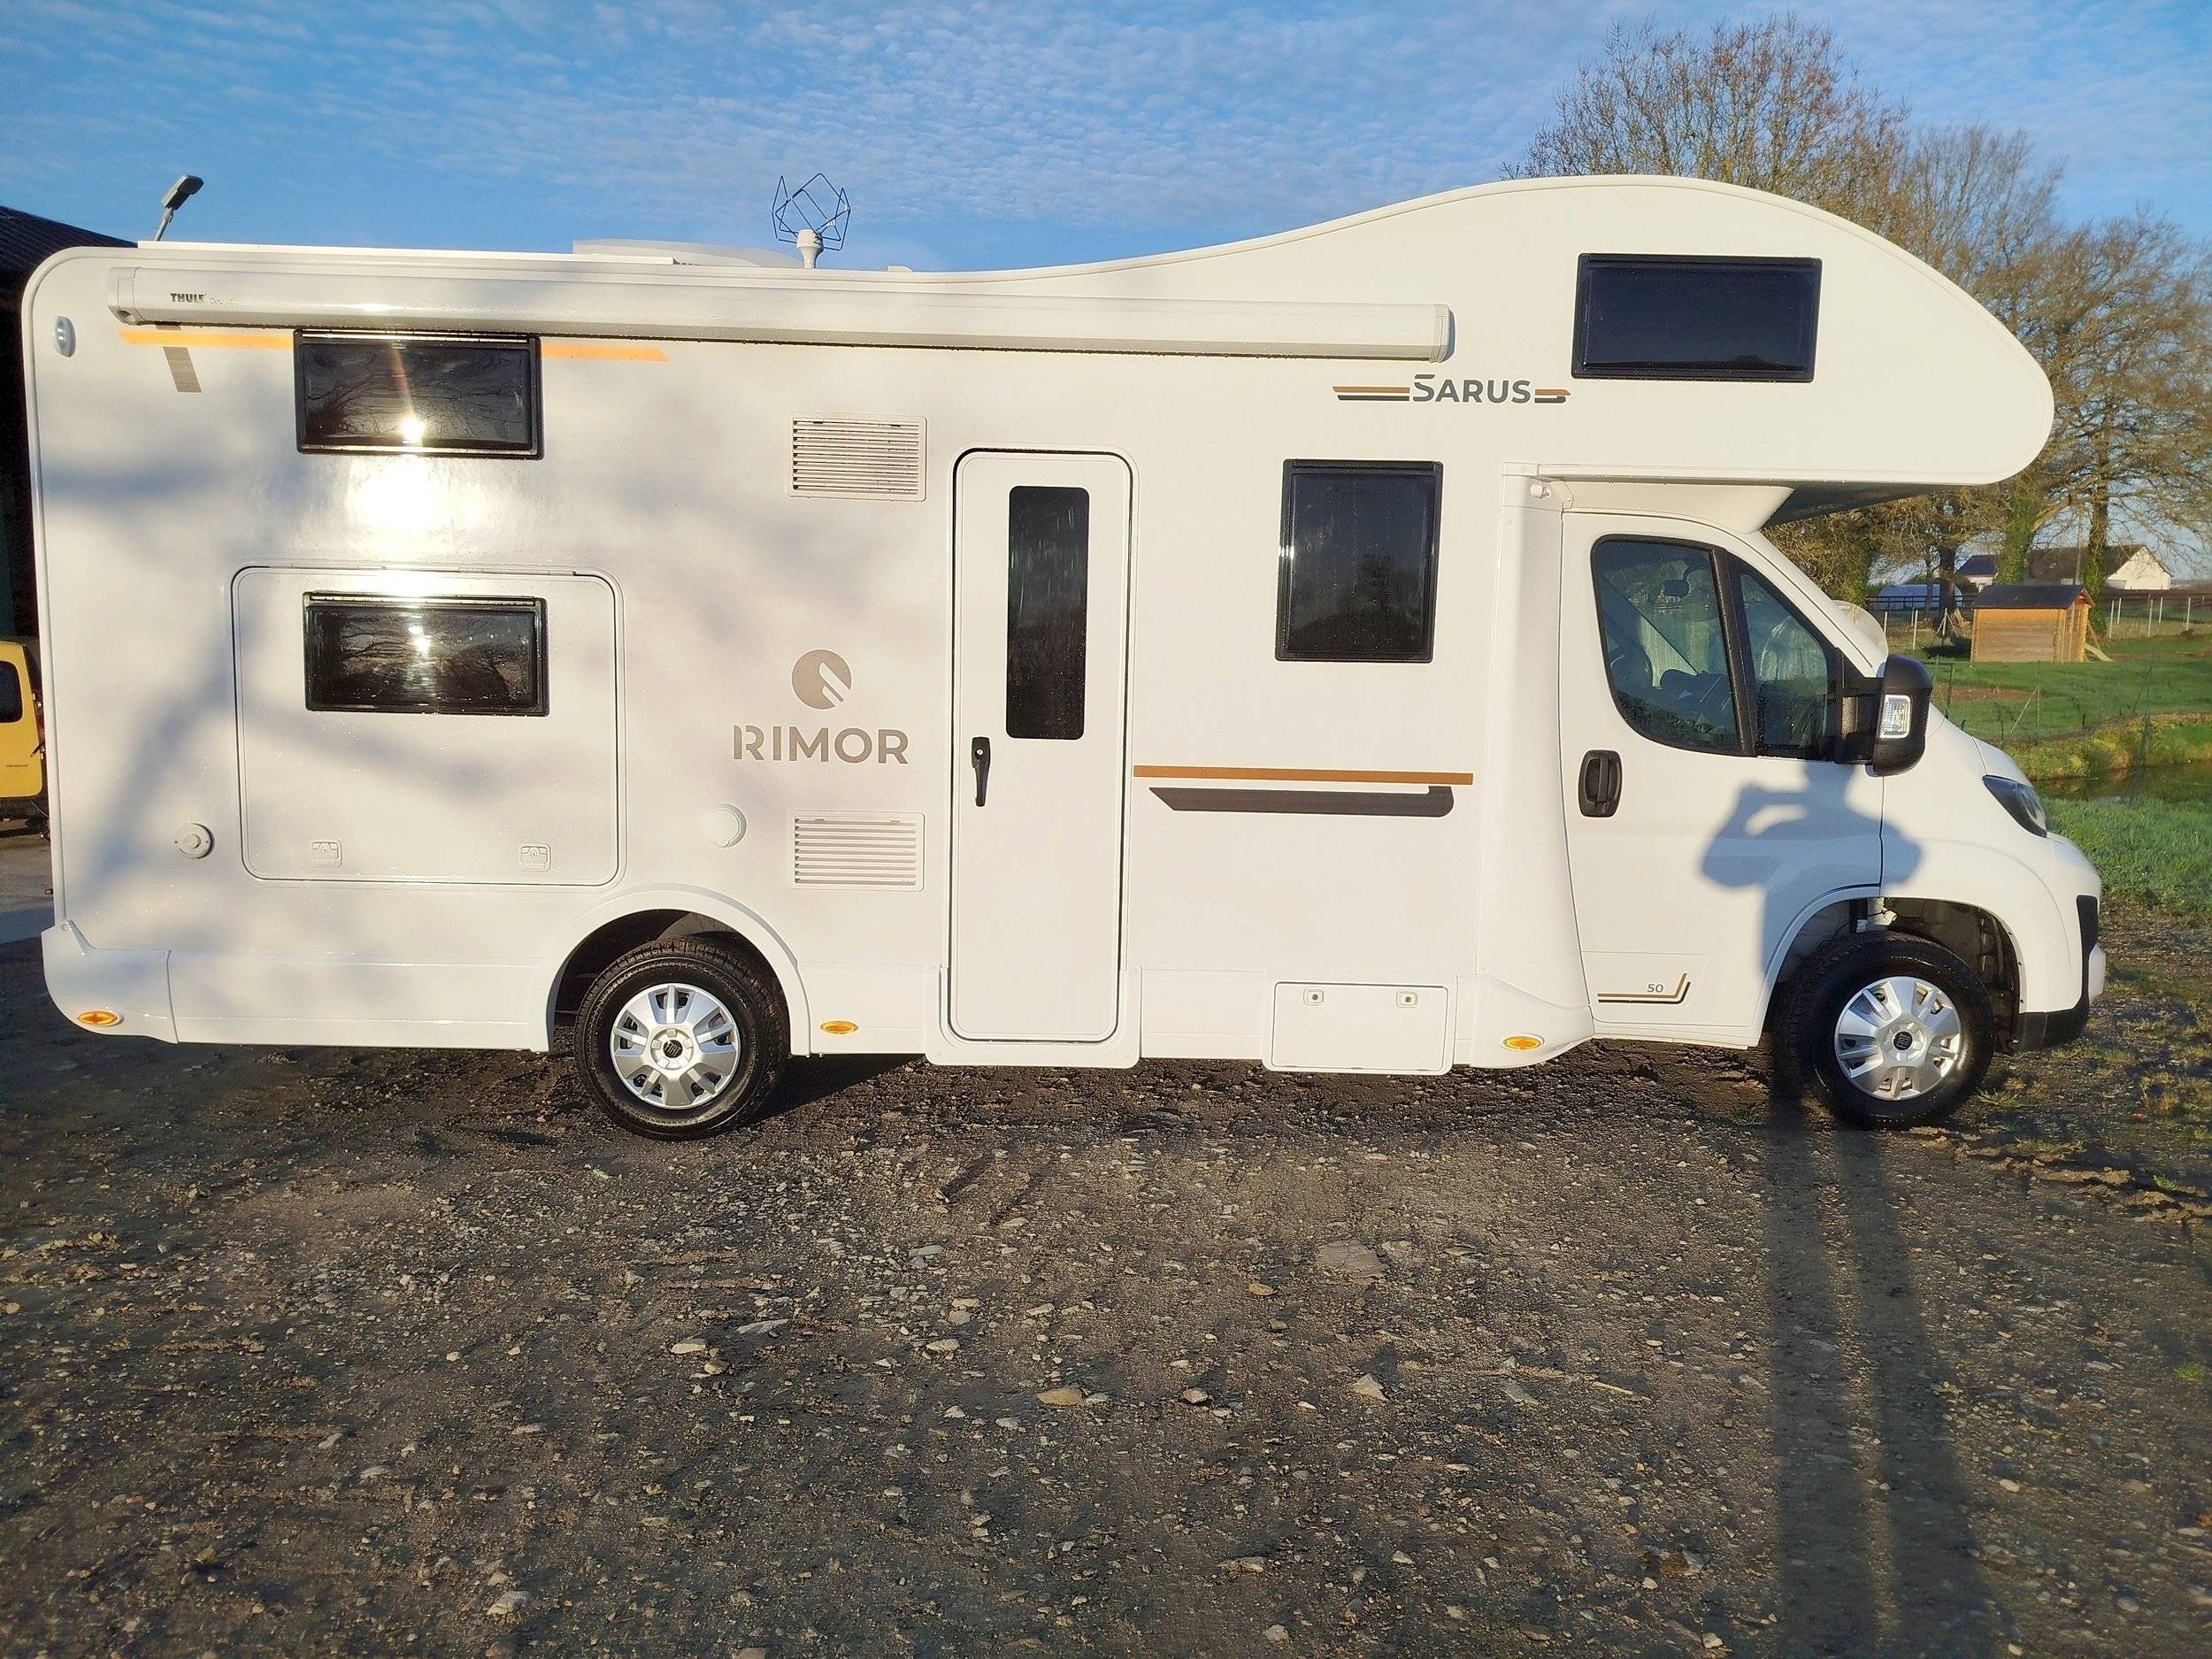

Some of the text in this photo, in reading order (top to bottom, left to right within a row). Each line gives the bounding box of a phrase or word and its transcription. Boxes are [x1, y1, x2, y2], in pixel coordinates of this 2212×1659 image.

[170, 293, 204, 303] THULE
[1413, 374, 1532, 403] SARUS
[733, 725, 909, 764] RIMOR
[1647, 984, 1664, 993] 50
[664, 1041, 681, 1057] FIAT
